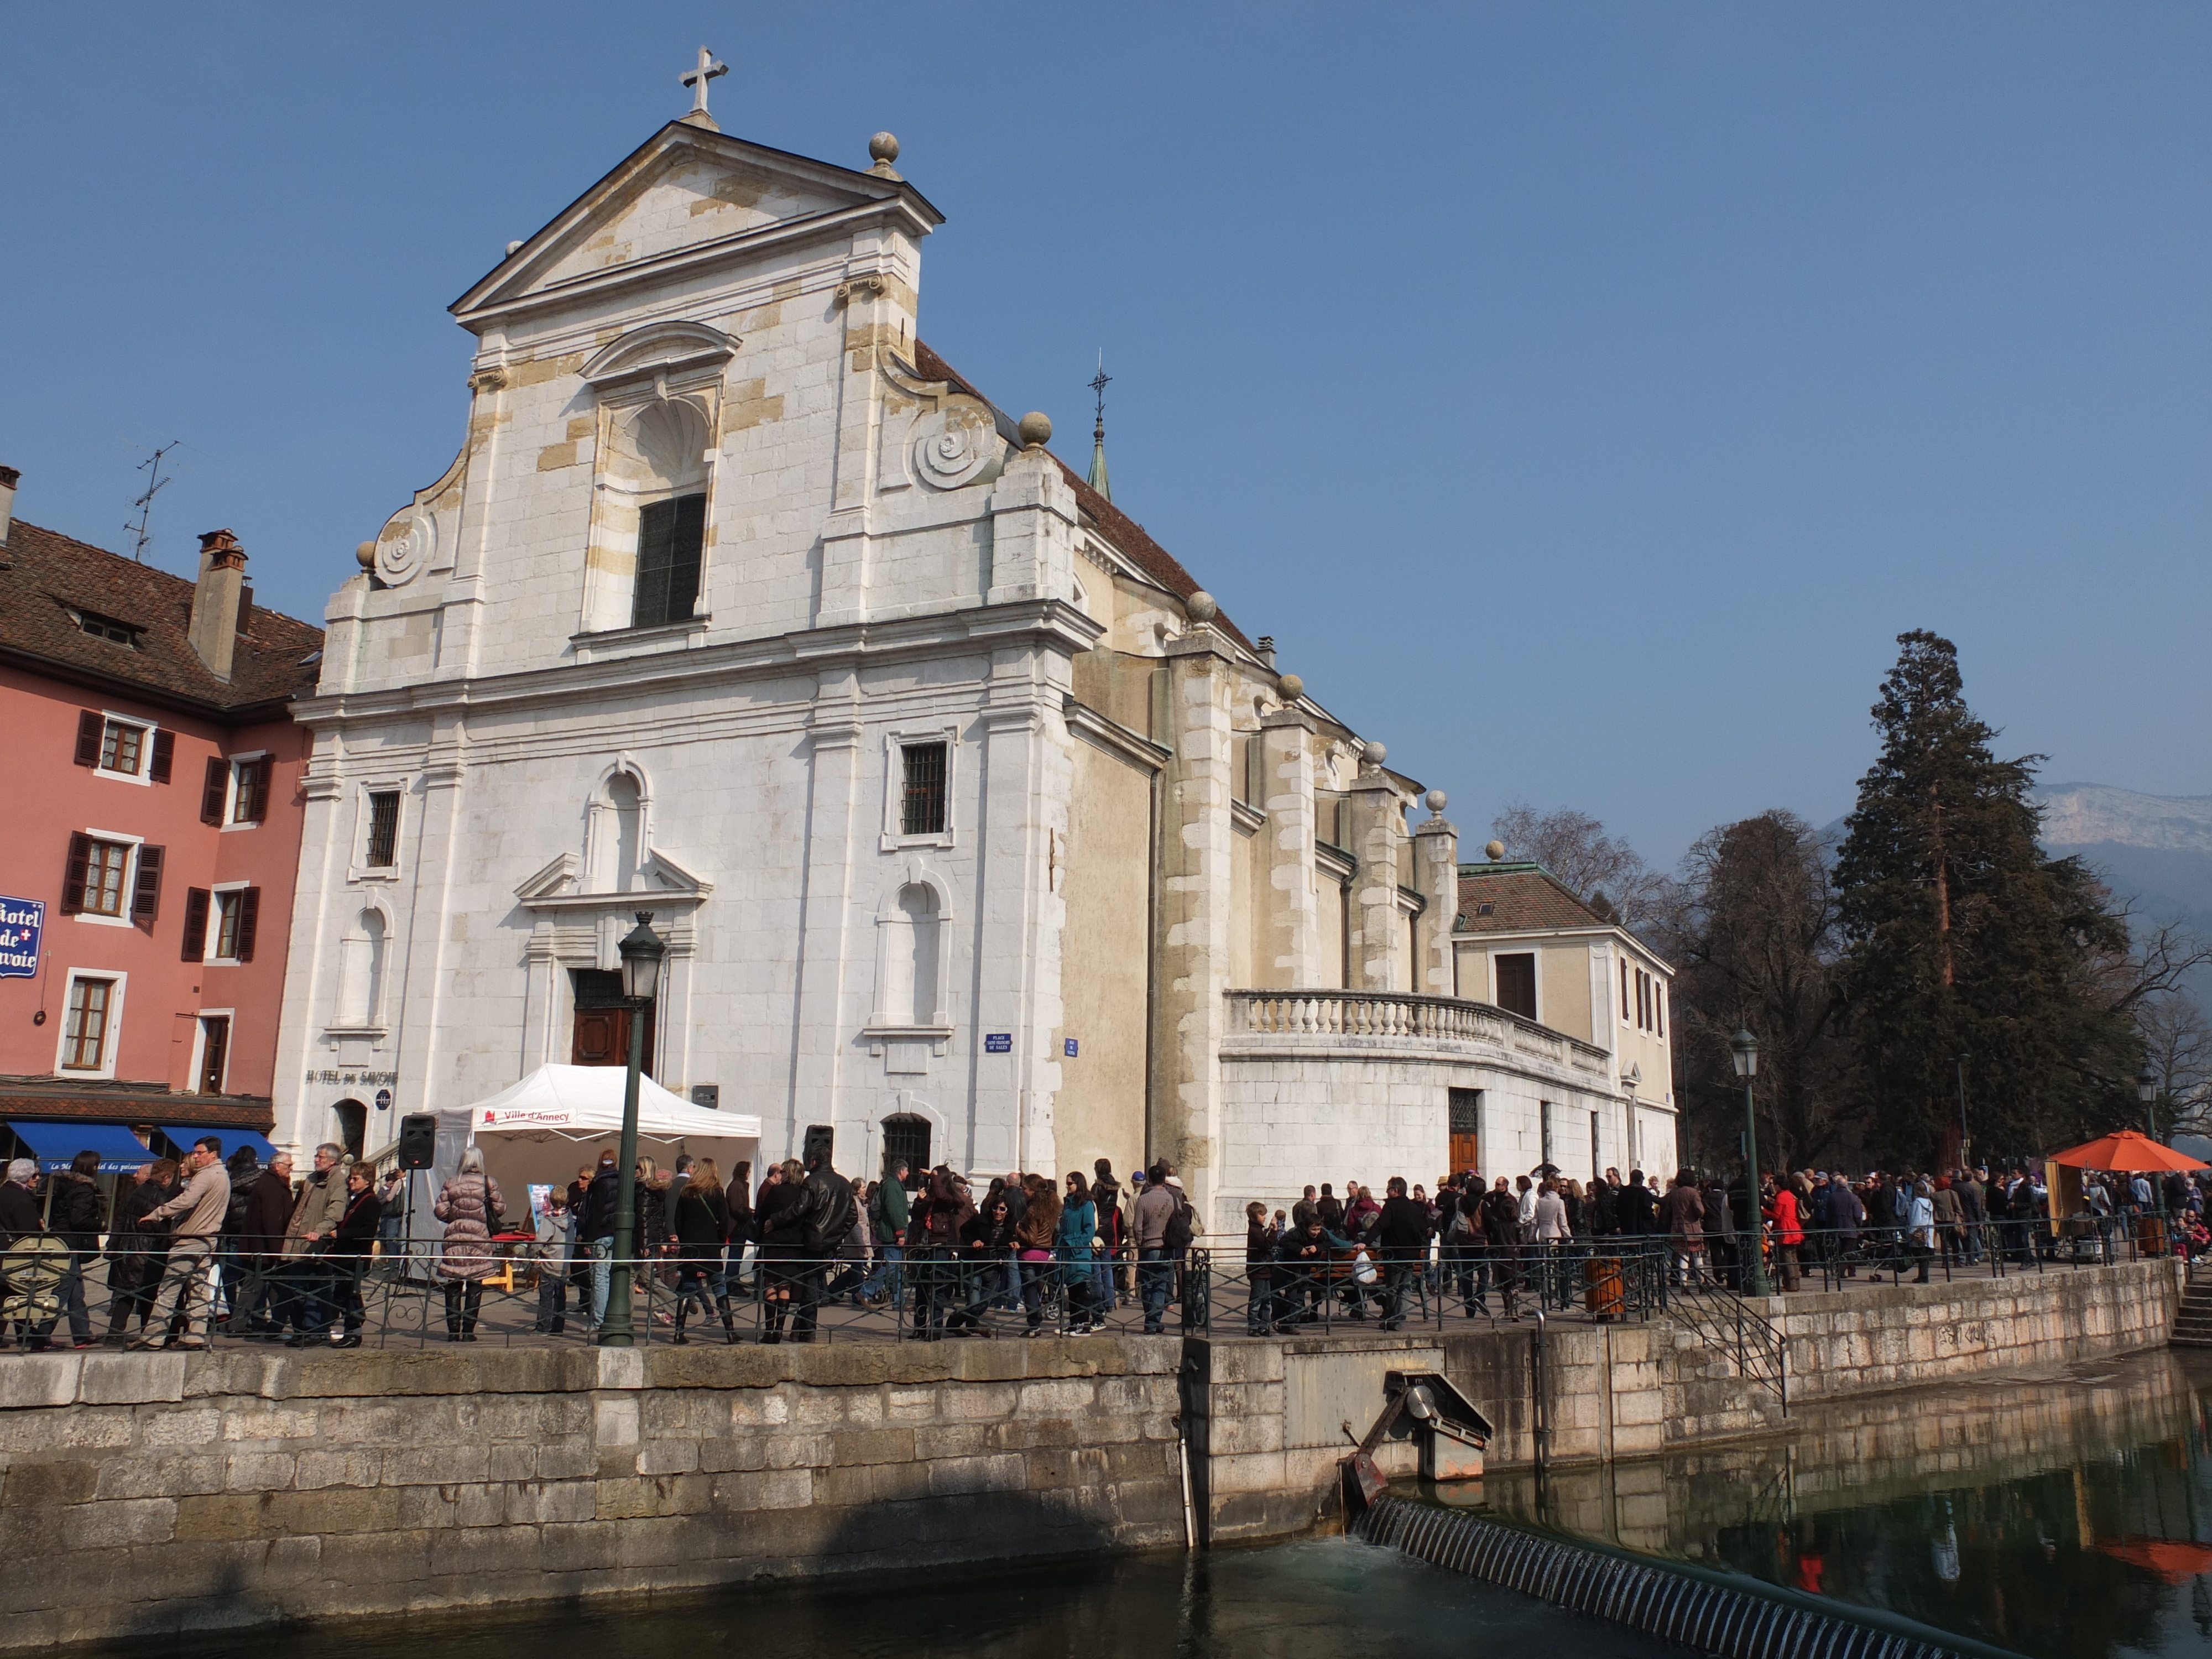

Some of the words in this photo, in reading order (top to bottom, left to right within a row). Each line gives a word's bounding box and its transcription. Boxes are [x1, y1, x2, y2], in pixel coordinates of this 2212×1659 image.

[0, 928, 20, 948] de
[307, 1070, 341, 1082] HOTEL
[362, 1071, 399, 1083] SAVOIE
[504, 1110, 526, 1119] Ville
[528, 1112, 569, 1122] d'Annecy
